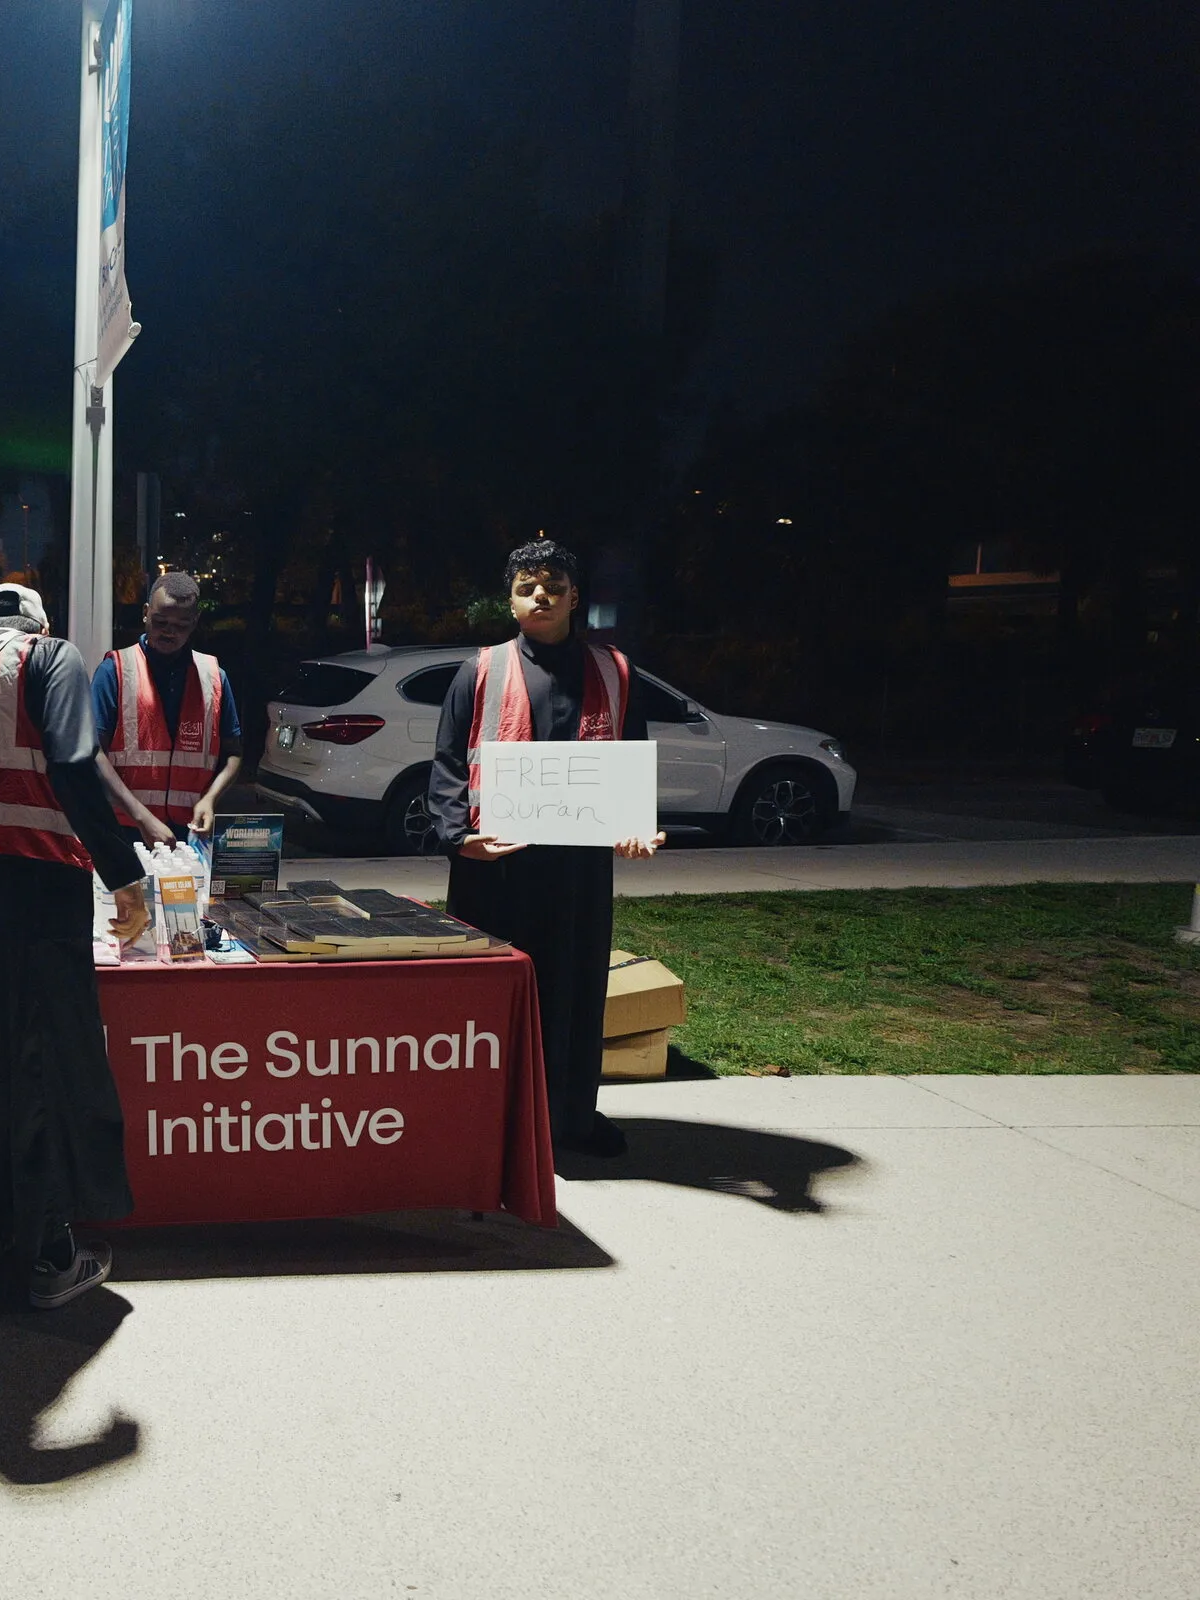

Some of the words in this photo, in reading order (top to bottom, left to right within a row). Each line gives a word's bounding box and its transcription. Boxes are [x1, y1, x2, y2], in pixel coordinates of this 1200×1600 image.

[495, 756, 601, 787] FREE
[131, 1032, 249, 1083] The
[265, 1020, 500, 1078] Sunnah
[147, 1098, 404, 1156] Initiative
